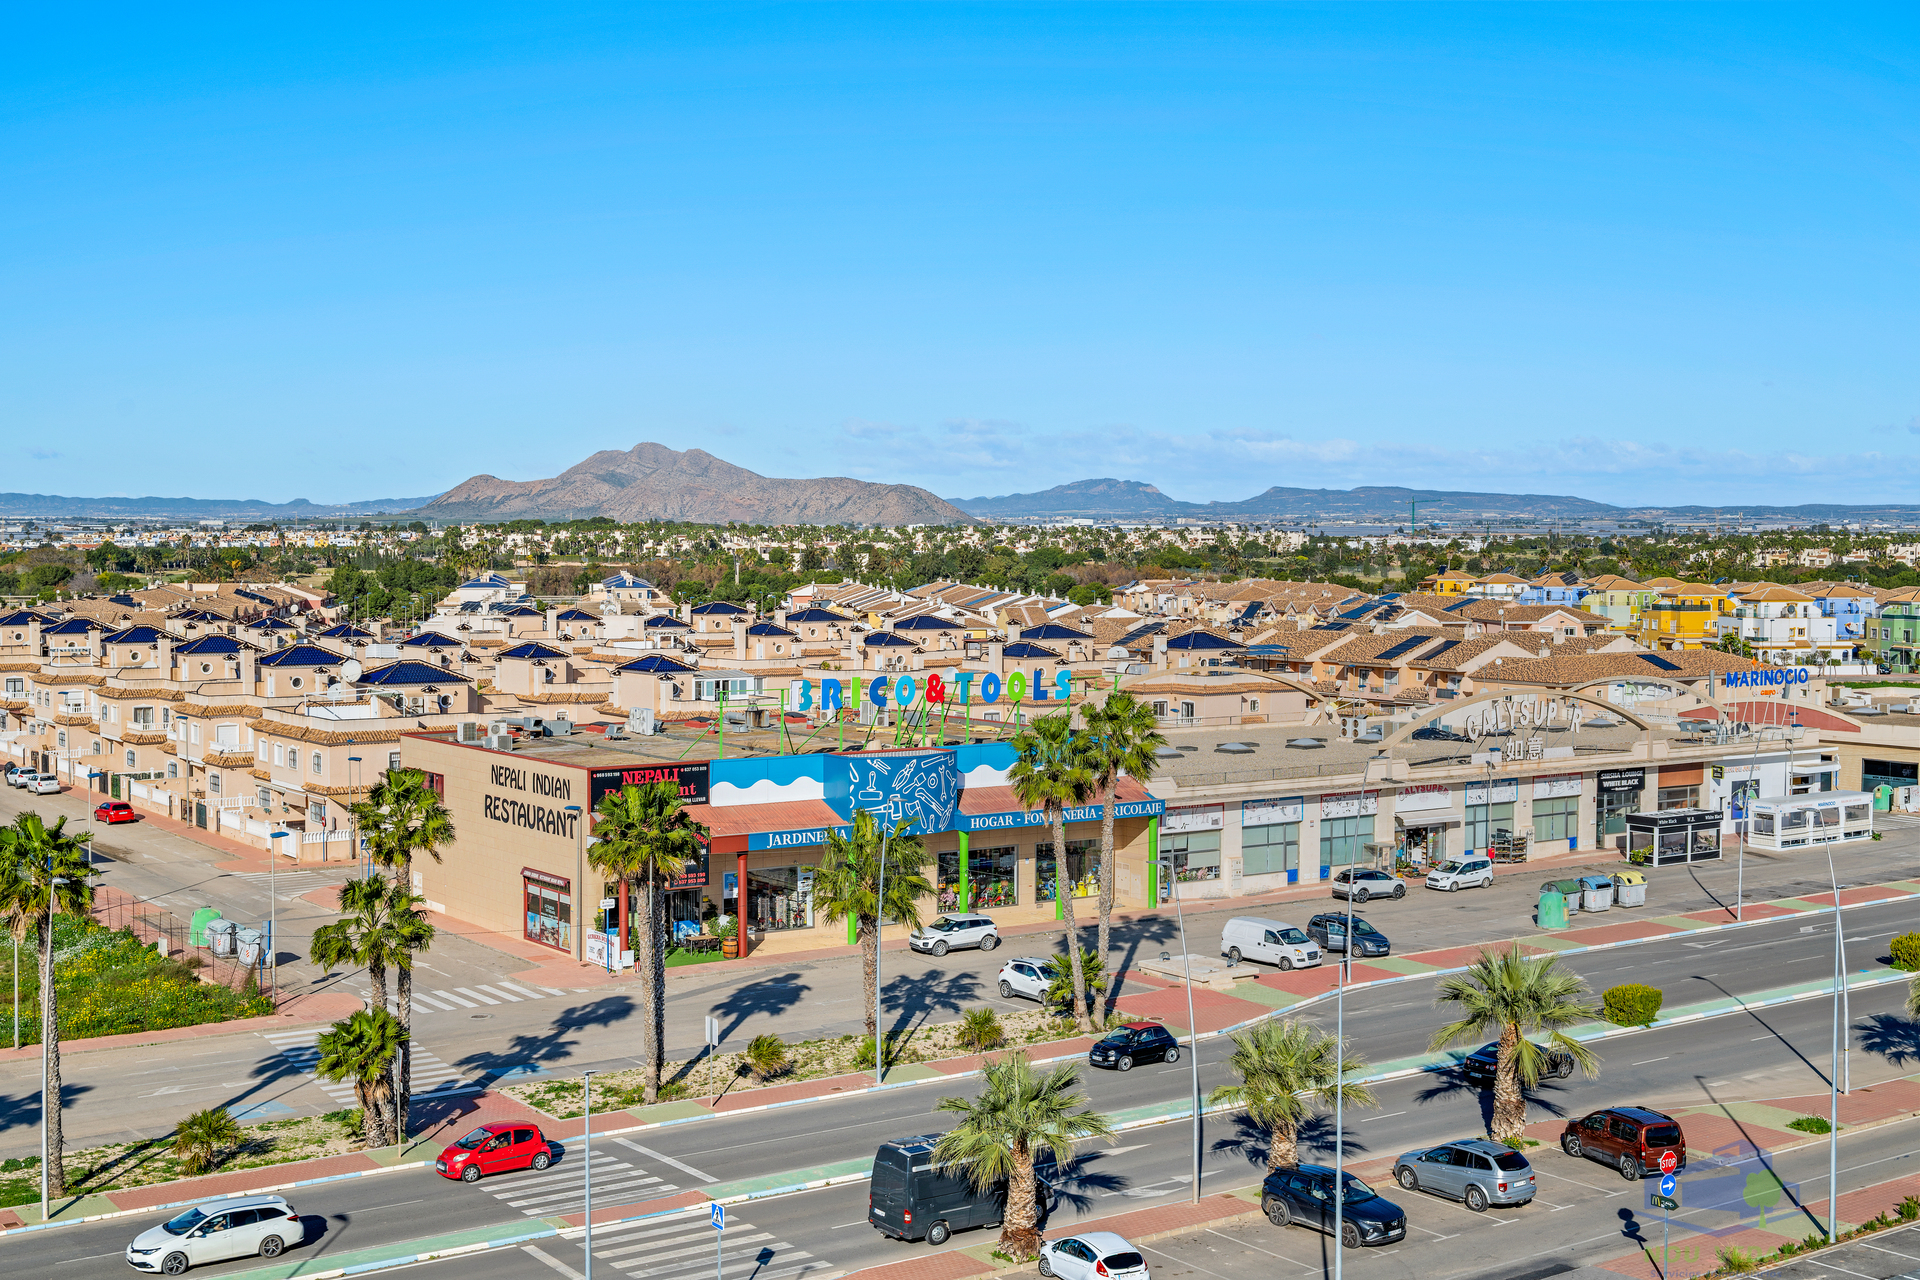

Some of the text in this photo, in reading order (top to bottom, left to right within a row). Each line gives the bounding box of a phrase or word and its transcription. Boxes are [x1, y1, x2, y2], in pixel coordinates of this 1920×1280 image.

[1726, 668, 1808, 688] MARINOCIO
[1506, 736, 1544, 761] 如意
[491, 764, 526, 791] NEPALI
[532, 772, 571, 800] INDIAN
[622, 768, 680, 785] NEPALI
[1603, 780, 1620, 788] WHITE
[484, 794, 577, 839] RESTAURANT
[970, 815, 1014, 829] HOGAR
[1024, 808, 1097, 824] FONNERÍA
[1113, 802, 1162, 816] RICOLAJE
[1661, 1157, 1676, 1169] STOP
